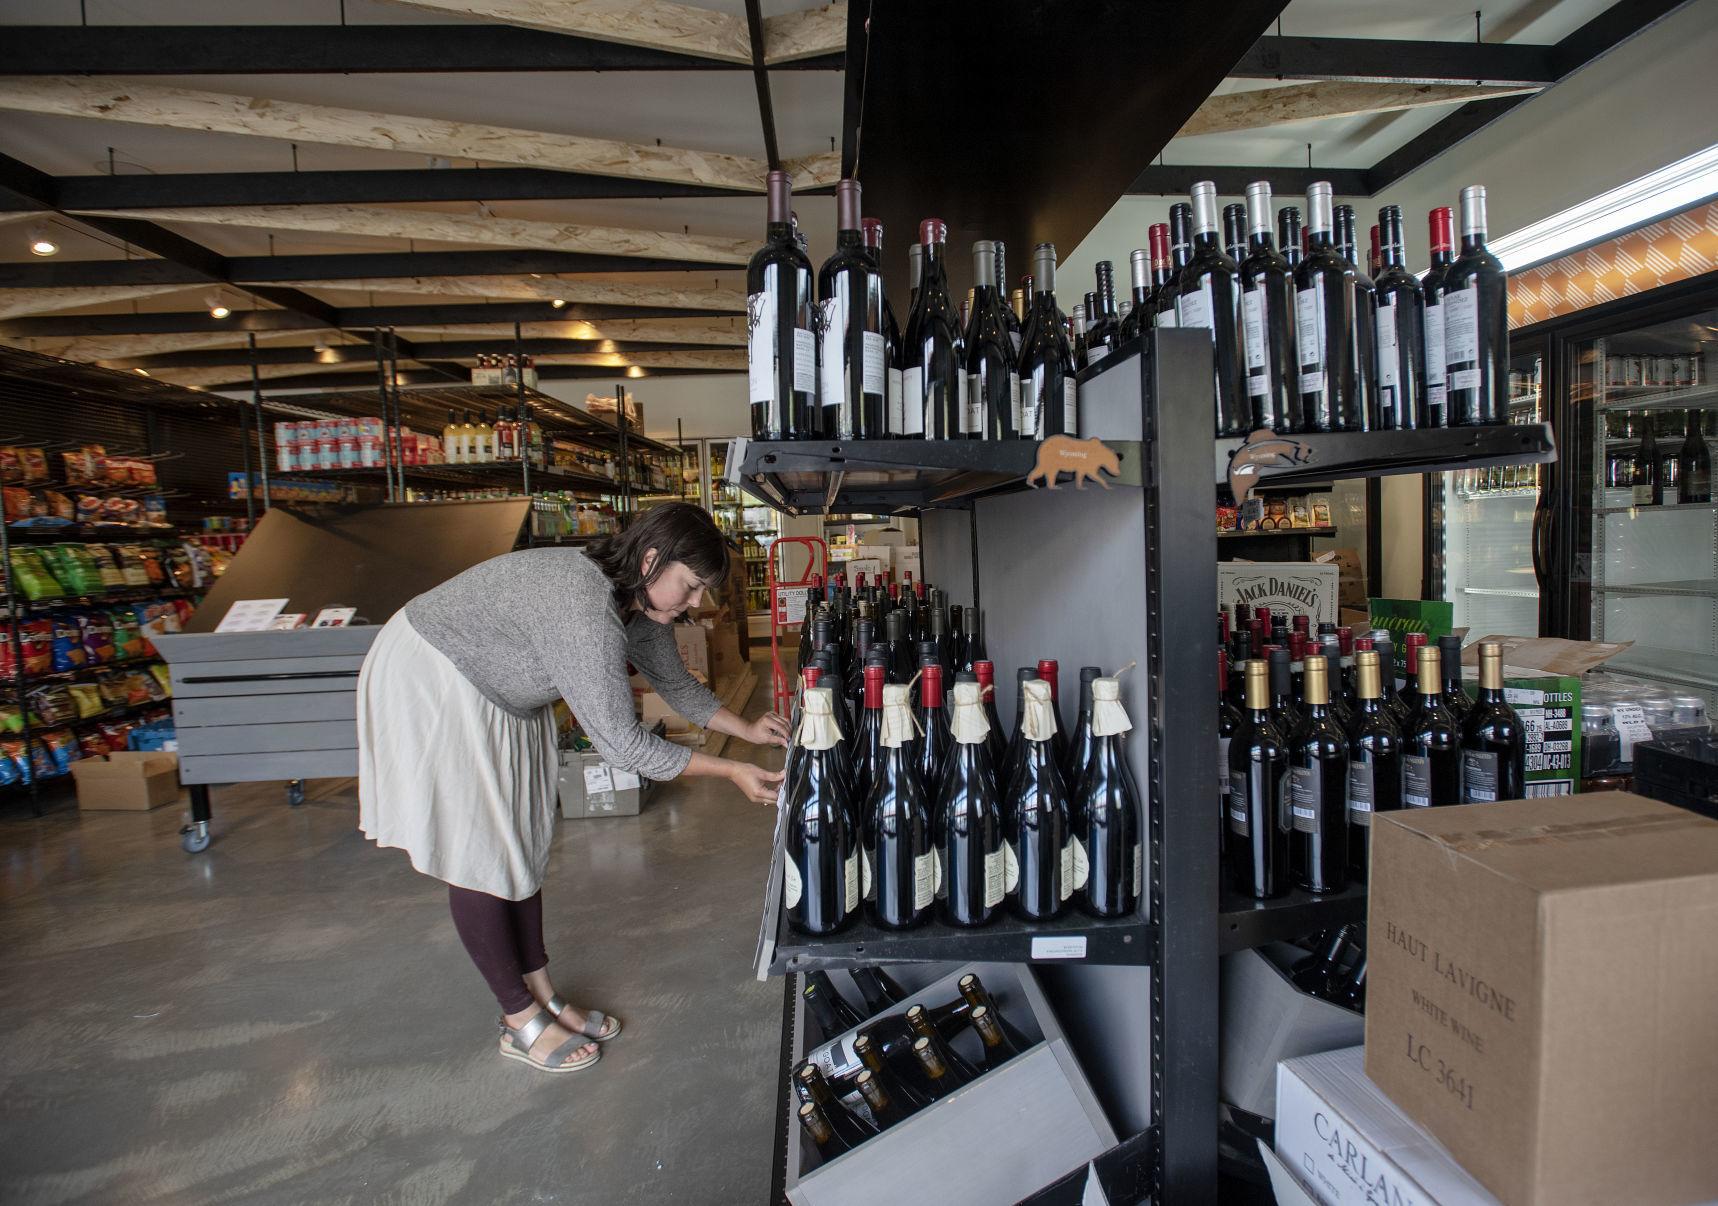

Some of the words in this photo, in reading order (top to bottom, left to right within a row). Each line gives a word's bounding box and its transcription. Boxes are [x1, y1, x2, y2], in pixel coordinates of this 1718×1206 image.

[1543, 692, 1573, 702] OTTLES
[1386, 921, 1429, 963] HAUT
[1434, 951, 1517, 1022] LAVIGNE
[1411, 989, 1450, 1028] WHITE
[1450, 1016, 1485, 1054] WINE
[1406, 1033, 1432, 1072] LC
